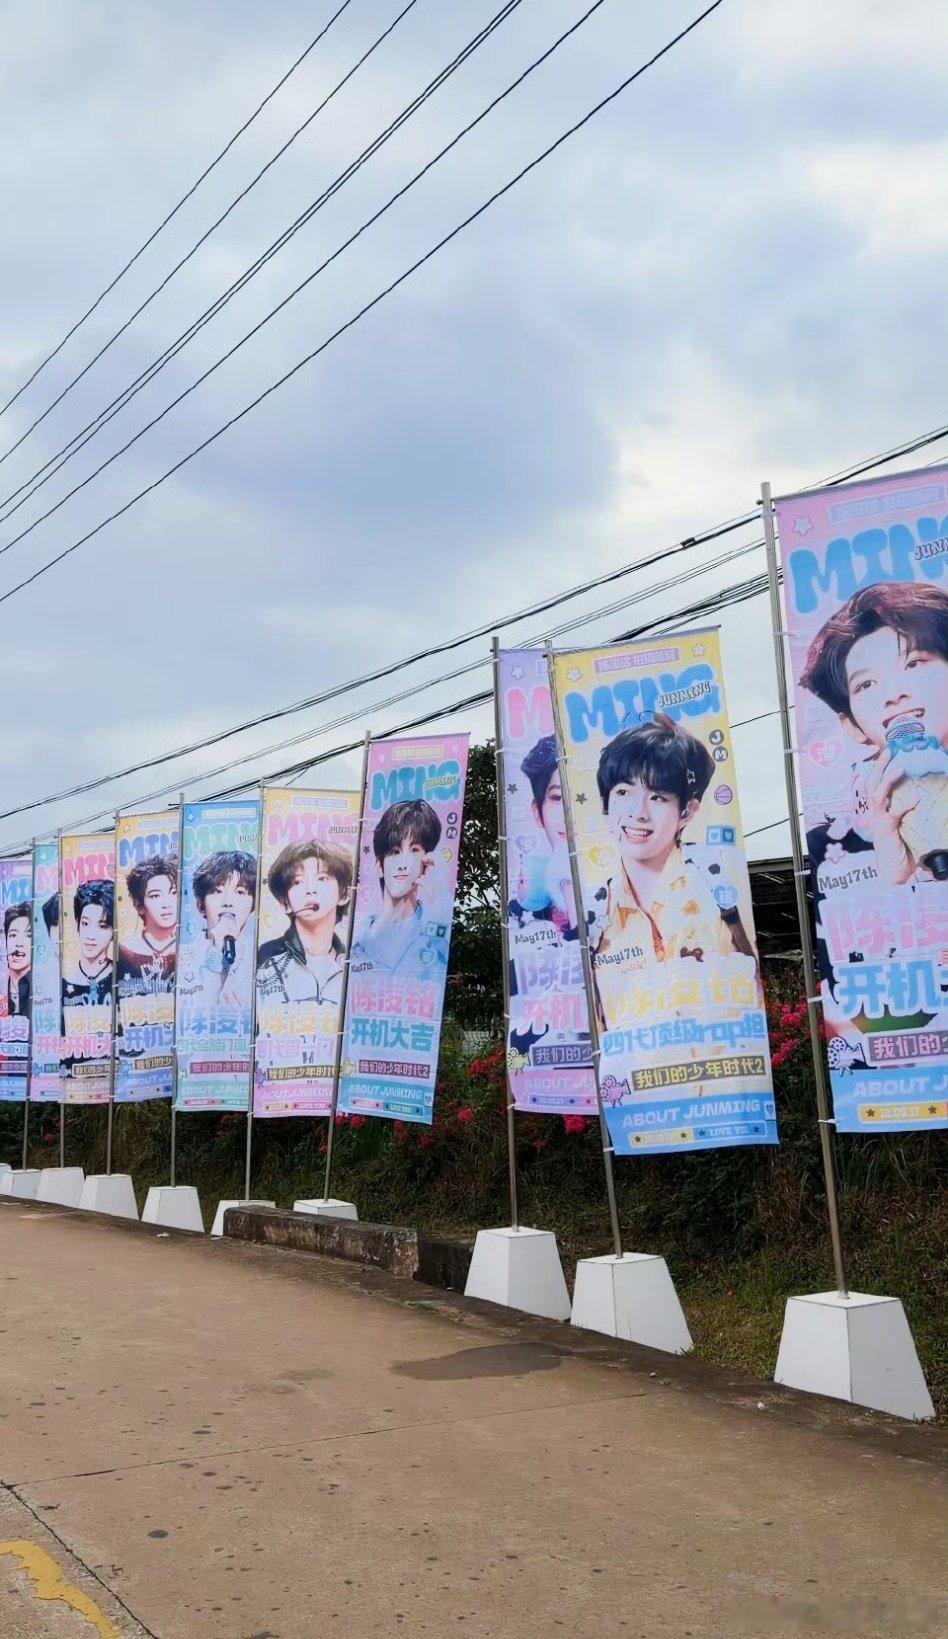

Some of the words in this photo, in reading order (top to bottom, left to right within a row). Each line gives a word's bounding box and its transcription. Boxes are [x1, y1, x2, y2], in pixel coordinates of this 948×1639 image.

[565, 663, 722, 743] MING
[657, 681, 713, 707] JUNMING
[371, 760, 461, 811] MING
[818, 866, 879, 893] May17th
[514, 930, 557, 945] May17th
[597, 947, 644, 967] May17th
[838, 960, 948, 1015] 开机
[522, 994, 588, 1032] 开机
[351, 1018, 434, 1052] 开机大吉
[873, 1034, 948, 1060] 我们的
[360, 1060, 430, 1078] 我们的少年时代2
[635, 1058, 765, 1089] 我们的少年时代2
[348, 1083, 380, 1096] ABOUT
[853, 1075, 930, 1099] ABOUT
[622, 1108, 680, 1129] ABOUT
[683, 1100, 760, 1120] JUNMING
